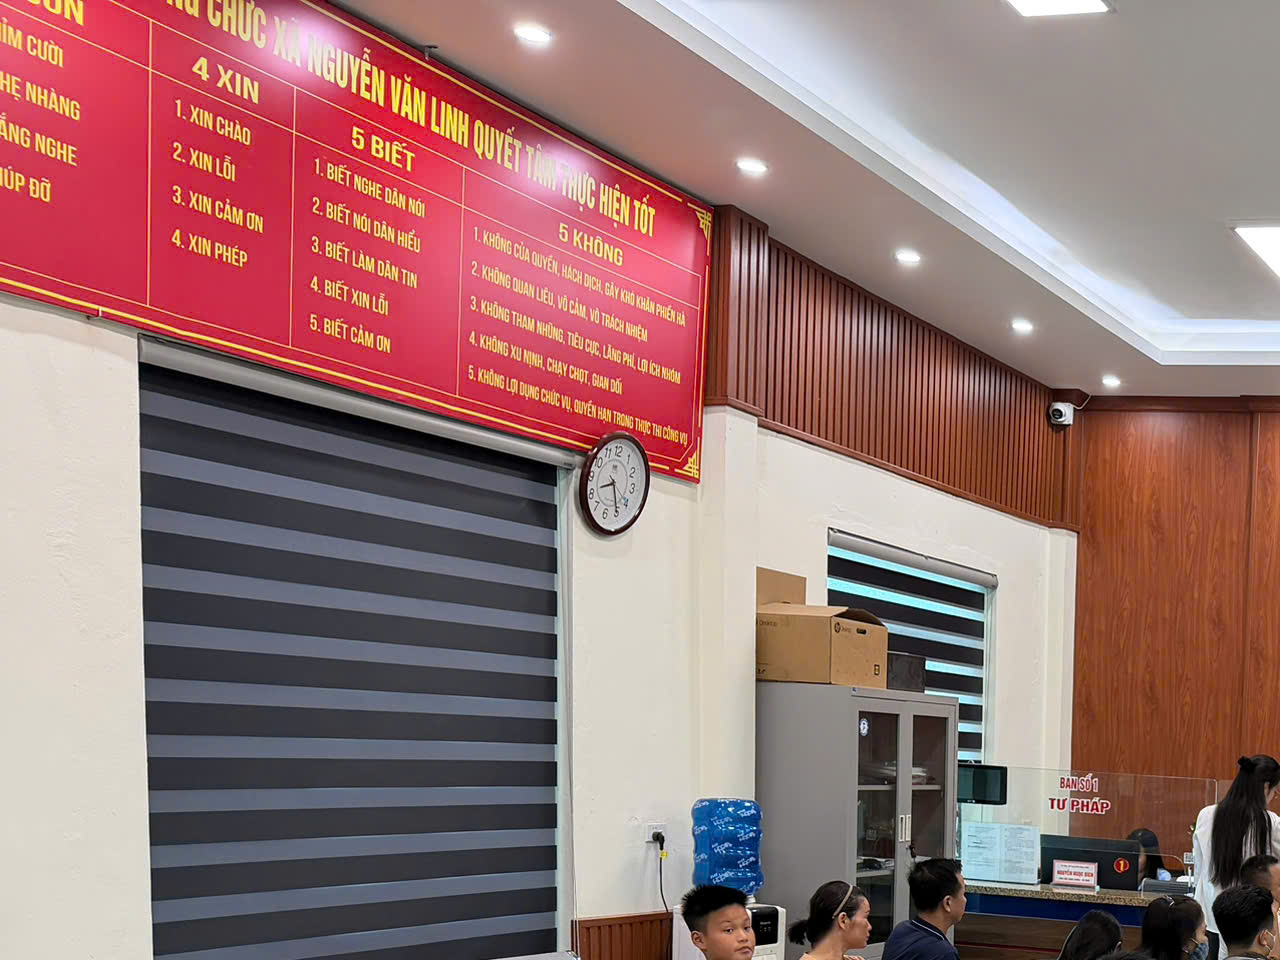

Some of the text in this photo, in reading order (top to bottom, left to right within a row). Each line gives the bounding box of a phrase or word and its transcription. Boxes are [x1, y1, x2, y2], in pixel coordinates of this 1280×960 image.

[0, 17, 64, 68] ỈM CƯỜI
[0, 70, 80, 121] HẸ NHÀNG
[192, 57, 259, 104] 4 XIN
[0, 112, 77, 167] ẮNG NGHE
[175, 100, 251, 146] 1. XIN CHÀO
[307, 33, 385, 107] NGUYỄN
[391, 74, 426, 127] VĂN
[431, 96, 469, 148] LINH
[473, 120, 522, 173] QUYẾT
[525, 143, 556, 191] TÂM
[561, 163, 596, 211] THỰC
[599, 183, 631, 228] HIỆN
[633, 194, 656, 237] TỐT
[173, 142, 236, 182] 2. XIN LỖI
[352, 126, 415, 172] 5 BIẾT
[29, 176, 51, 203] ĐỠ
[172, 185, 264, 234] 3. XIN CẢM ƠN
[315, 158, 425, 218] 1. BIẾT NGHE DÂN NÓI
[312, 197, 420, 253] 2. BIẾT NÓI DÂN HIỂU
[559, 222, 623, 267] 5 KHÔNG
[171, 228, 248, 268] 4. XIN PHÉP
[311, 236, 417, 288] 3. BIẾT LÀM DÂN TIN
[310, 276, 389, 316] 4. BIẾT XIN LỖI
[483, 231, 512, 255] KHÔNG
[561, 263, 582, 285] HÁCH
[604, 280, 619, 300] GÂY
[620, 288, 635, 306] KHÓ
[636, 295, 655, 315] KHĂN
[676, 311, 686, 327] HÀ
[482, 265, 511, 289] KHÔNG
[512, 277, 535, 299] QUAN
[557, 295, 568, 312] VÔ
[601, 311, 625, 333] TRÁCH
[625, 321, 648, 342] NHIỆM
[309, 314, 391, 353] 5. BIẾT CẢM ƠN
[481, 299, 510, 324] KHÔNG
[511, 311, 535, 333] THAM
[567, 331, 583, 349] TIÊU
[661, 366, 681, 385] NHÓM
[479, 335, 509, 357] KHÔNG
[510, 345, 522, 361] XU
[546, 358, 568, 378] CHẠY
[591, 373, 609, 391] GIAN
[610, 377, 623, 395] DỐI
[478, 368, 505, 389] KHÔNG
[519, 382, 540, 400] DỤNG
[540, 388, 561, 407] CHỨC
[573, 400, 596, 419] QUYỀN
[612, 411, 634, 429] TRONG
[652, 423, 662, 438] THI
[662, 425, 679, 443] CÔNG
[594, 457, 603, 468] 10
[605, 448, 612, 459] 11
[614, 446, 623, 458] 12
[629, 467, 636, 478] 2
[588, 471, 595, 482] 9
[588, 488, 594, 500] 8
[629, 483, 635, 494] 3
[594, 501, 600, 511] 7
[602, 508, 608, 519] 6
[1060, 774, 1078, 791] BÀN
[1079, 773, 1093, 792] SỐ
[1048, 797, 1111, 815] TƯ PHÁP
